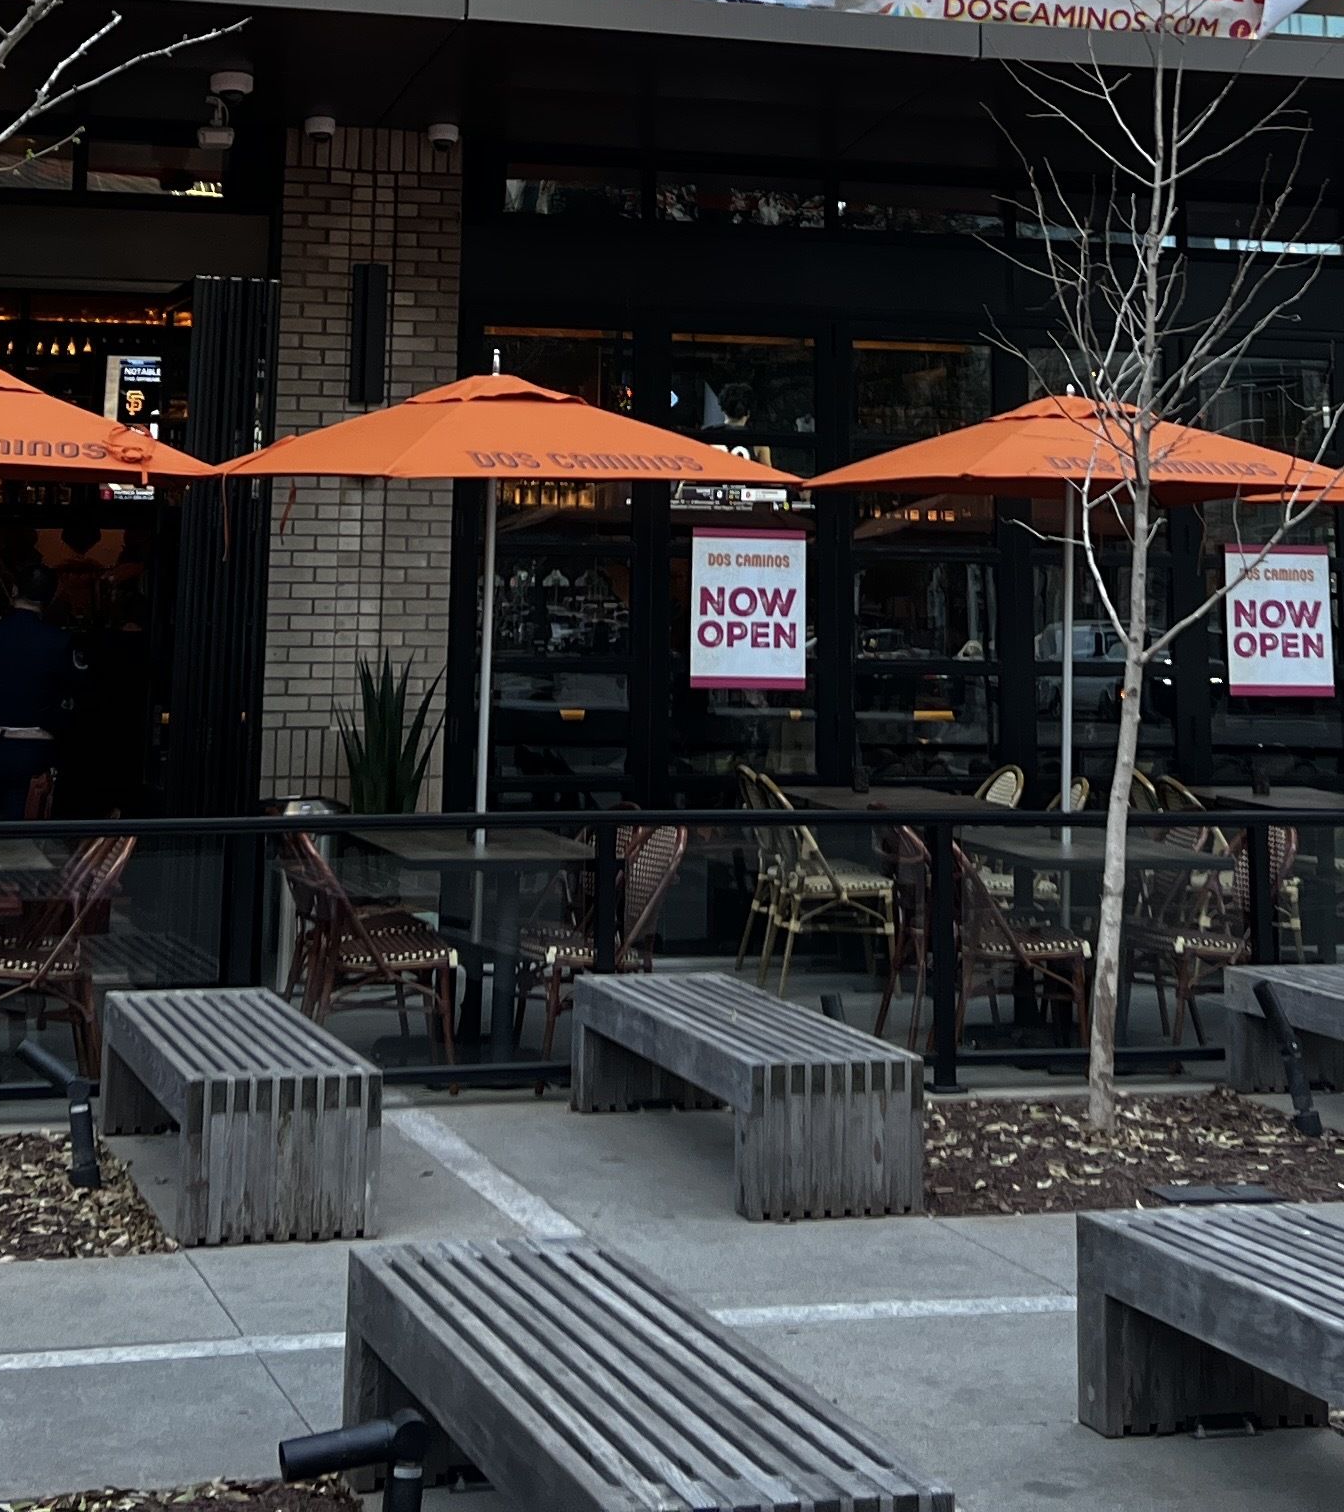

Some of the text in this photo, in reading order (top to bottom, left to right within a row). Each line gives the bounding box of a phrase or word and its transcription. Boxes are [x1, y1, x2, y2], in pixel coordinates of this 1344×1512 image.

[467, 450, 540, 469] DOS
[547, 452, 703, 472] CAMINOS
[1044, 455, 1116, 473] DOS
[708, 553, 790, 568] DOS CAMINOS
[1264, 568, 1314, 582] CAMINOS
[699, 586, 797, 617] NOW
[1234, 599, 1322, 629] NOW
[697, 620, 797, 649] OPEN
[1233, 632, 1324, 658] OPEN
